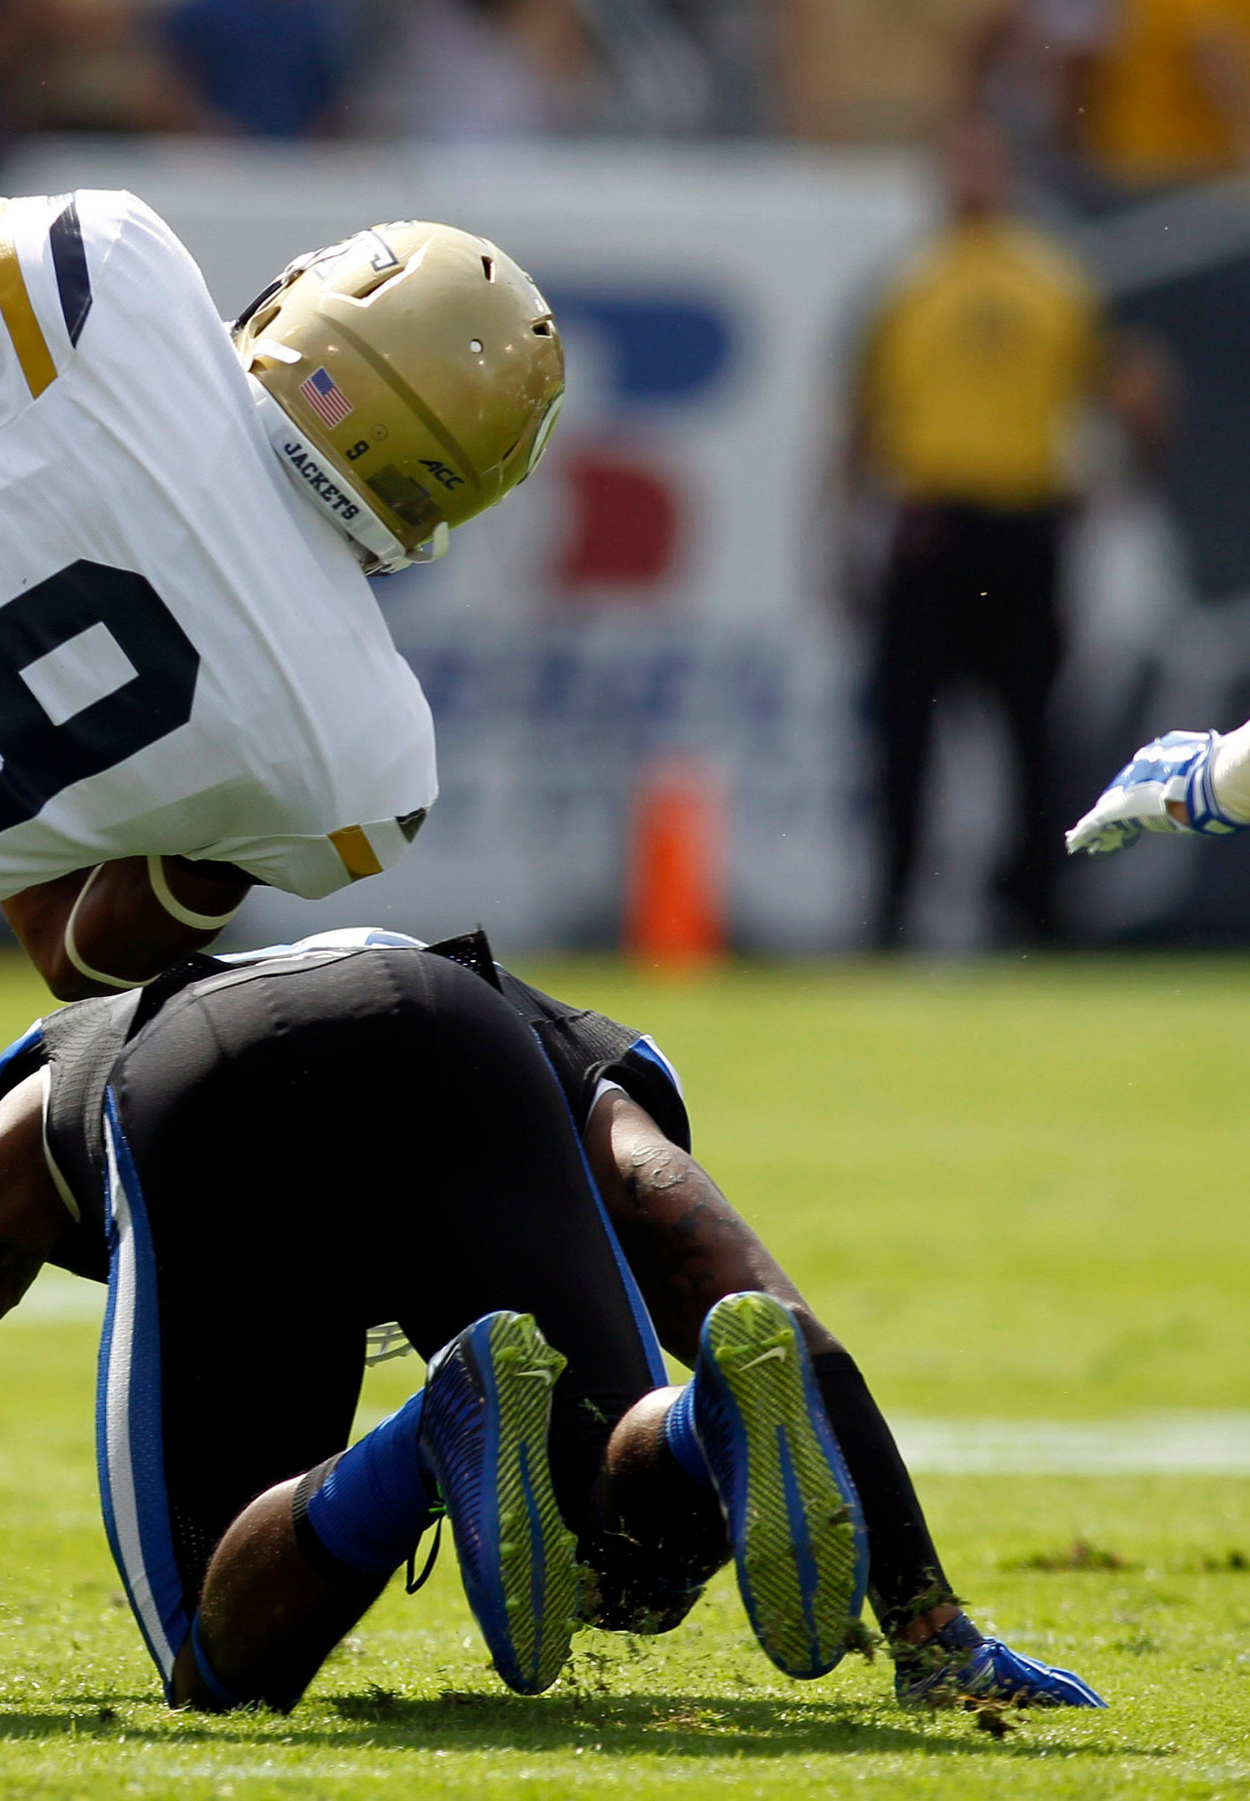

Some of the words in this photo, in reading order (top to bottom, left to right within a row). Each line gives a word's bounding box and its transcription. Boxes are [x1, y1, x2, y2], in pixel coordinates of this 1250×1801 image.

[346, 439, 370, 461] 9
[285, 442, 359, 520] JACKETS
[418, 458, 464, 491] ACC
